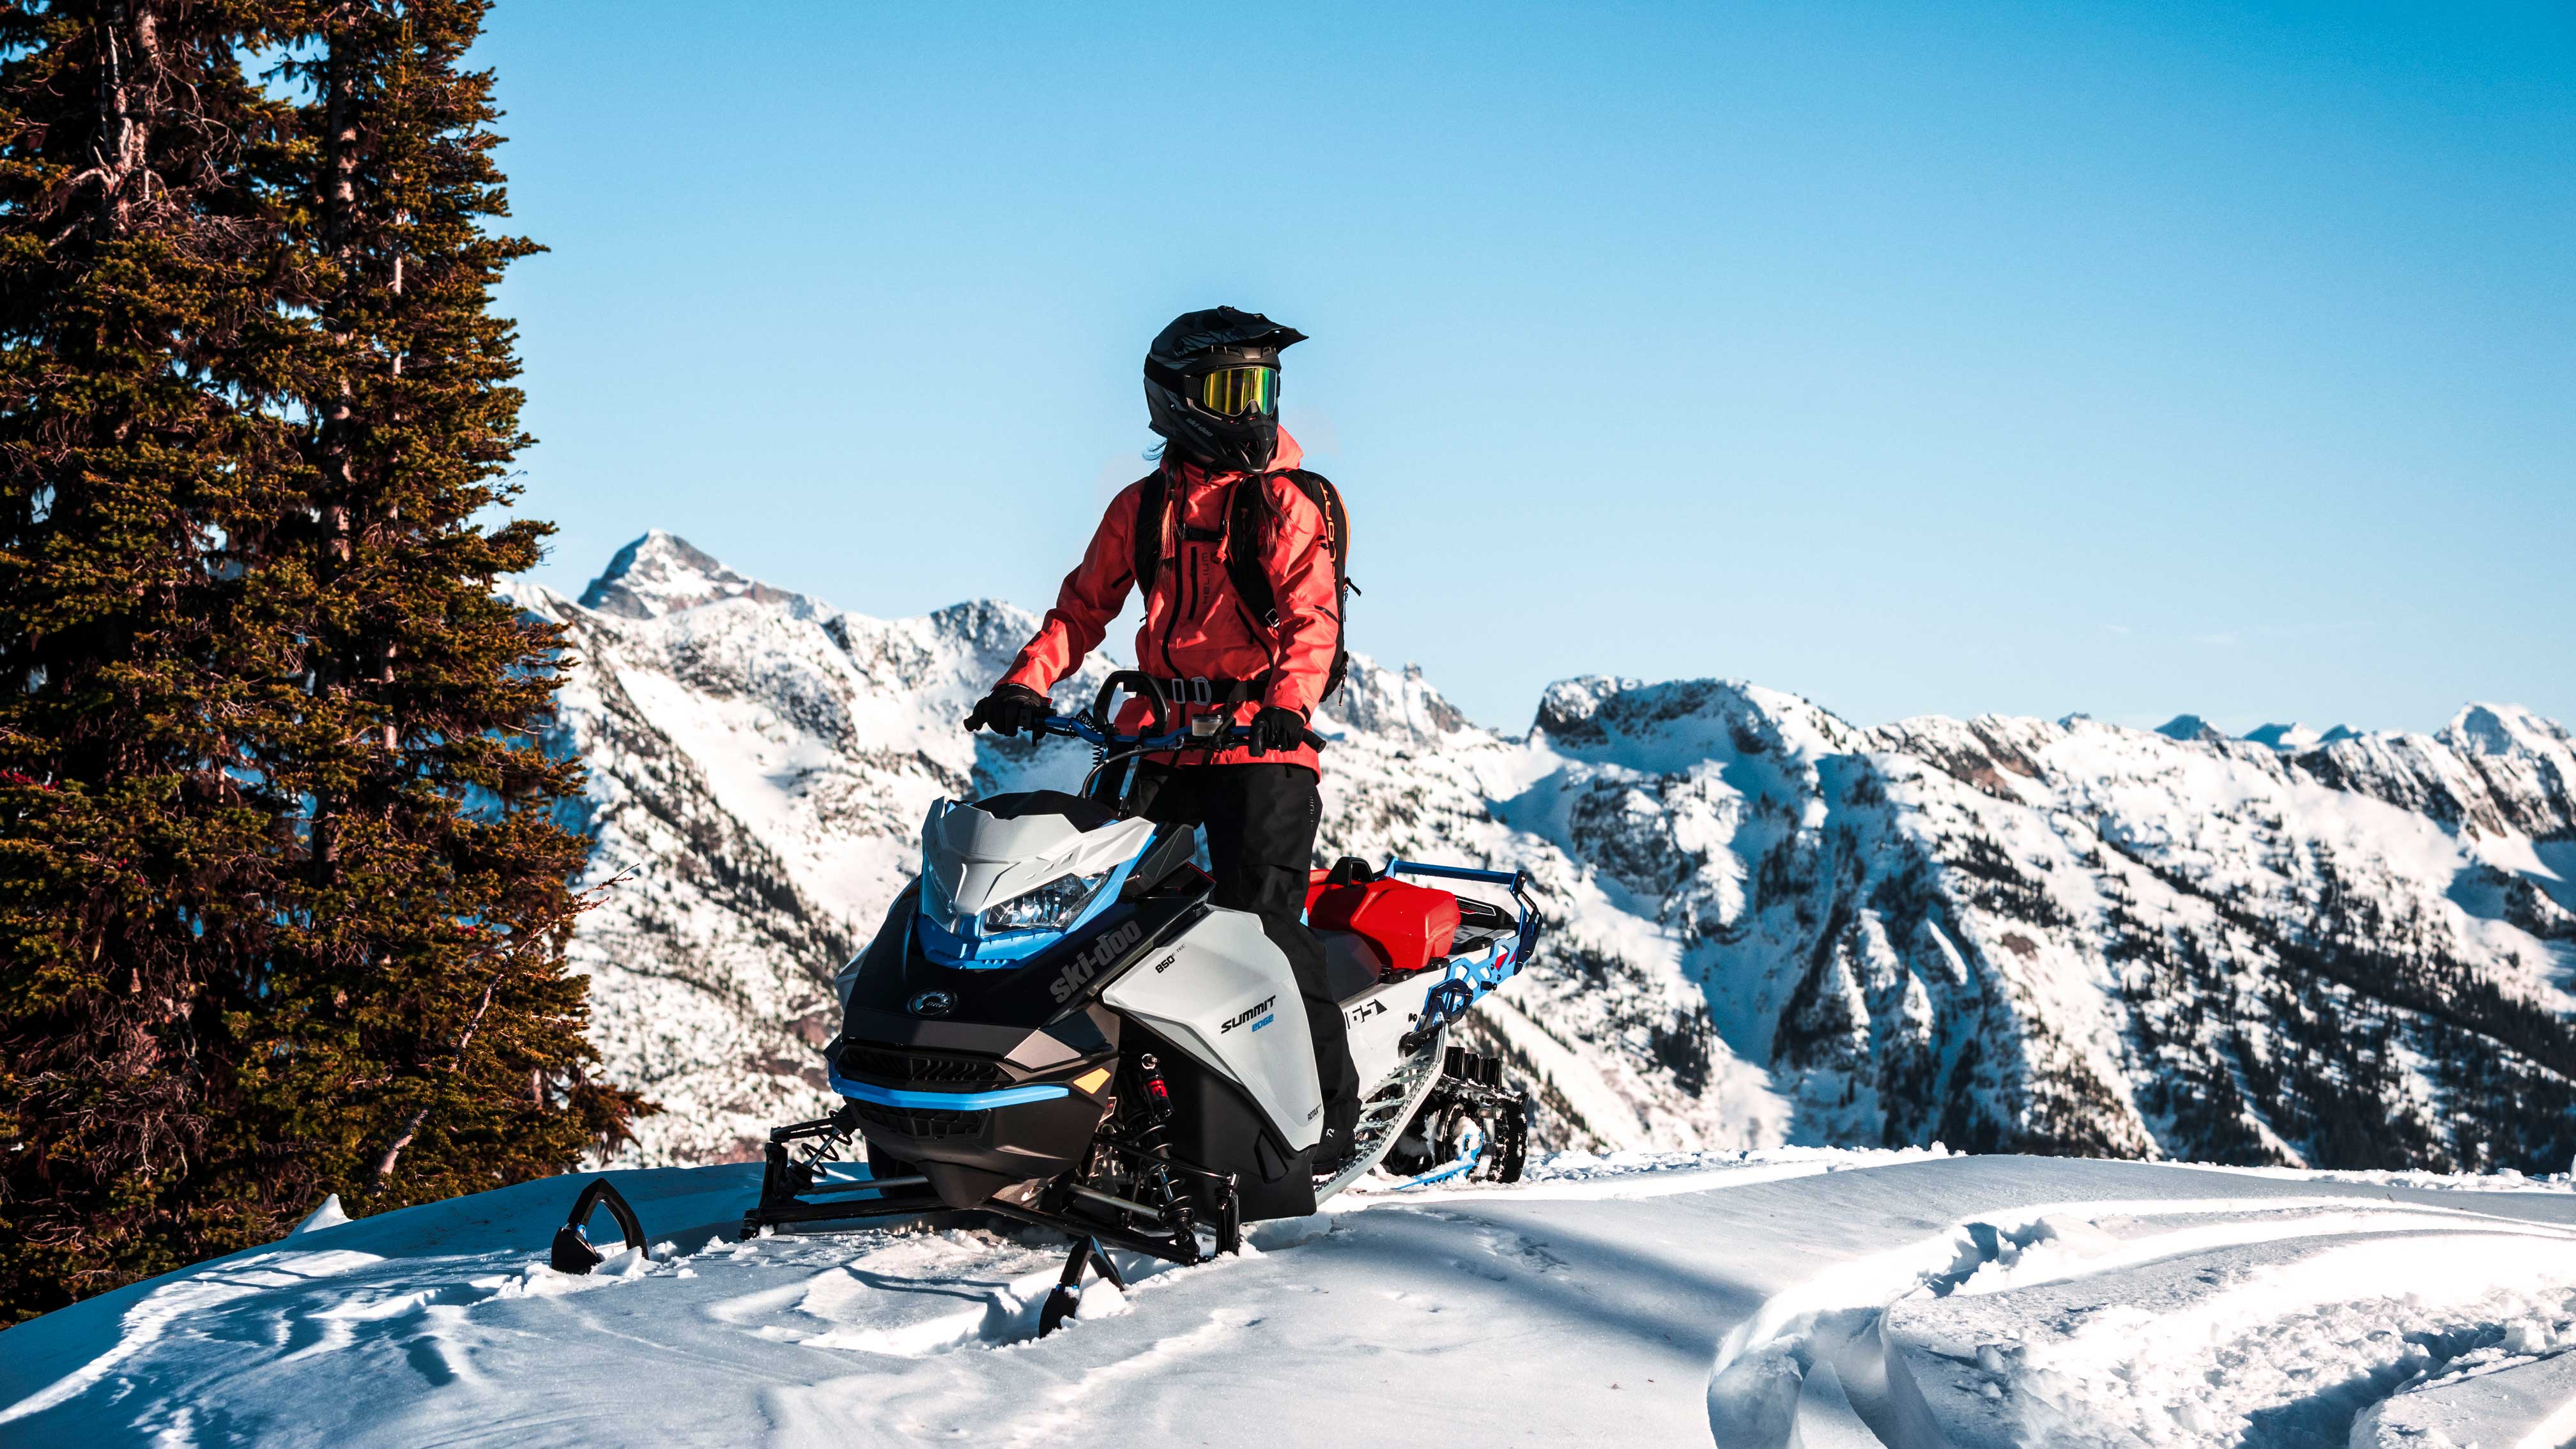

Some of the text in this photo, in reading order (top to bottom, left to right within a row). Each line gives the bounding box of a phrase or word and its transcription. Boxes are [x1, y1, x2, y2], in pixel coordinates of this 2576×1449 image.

[1202, 551, 1210, 604] HELIUM
[1050, 920, 1142, 1004] ski-doo
[1155, 954, 1176, 974] 850
[1221, 994, 1276, 1034] SUMMIT
